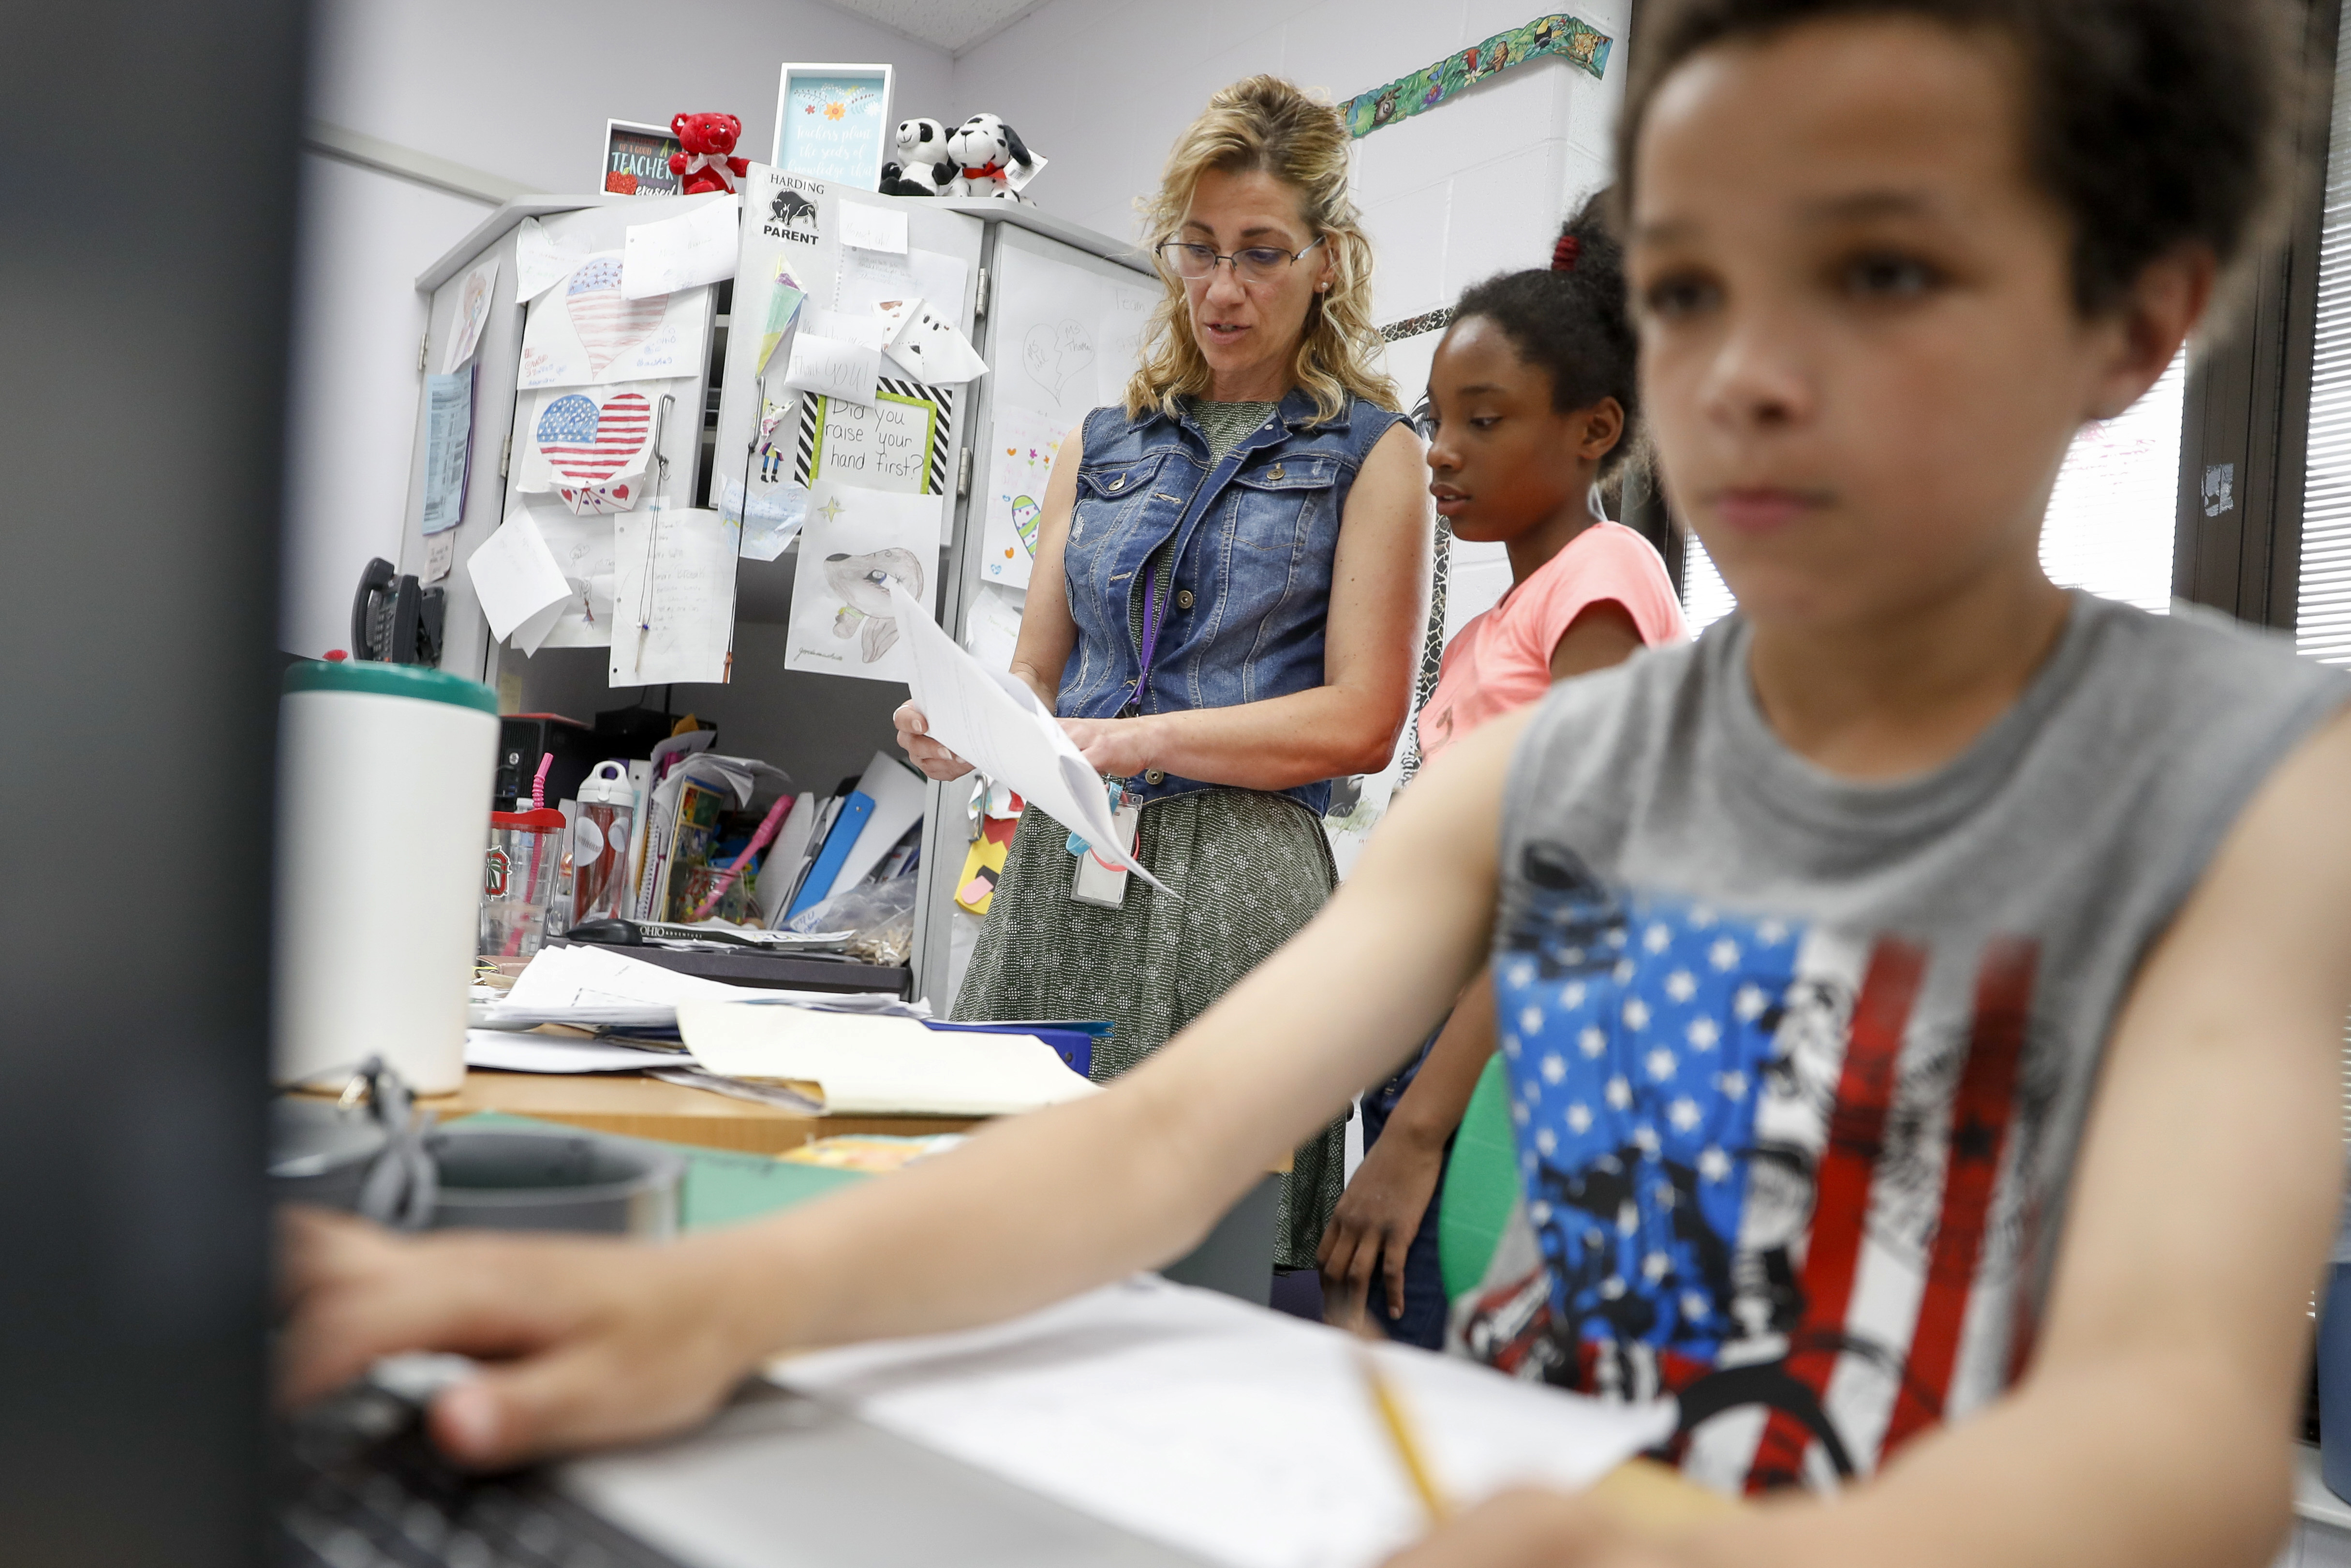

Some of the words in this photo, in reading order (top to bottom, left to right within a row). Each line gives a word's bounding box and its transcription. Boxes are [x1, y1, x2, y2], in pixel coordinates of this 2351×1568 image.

[796, 124, 838, 141] Teachers
[842, 125, 872, 143] plant
[619, 143, 627, 151] OF
[629, 145, 633, 153] A
[635, 146, 652, 155] GOOD
[799, 143, 816, 159] the
[821, 145, 849, 160] seeds
[853, 143, 867, 159] of
[851, 162, 873, 178] that
[636, 184, 676, 196] erased
[770, 174, 825, 195] HARDING
[764, 224, 819, 245] PARENT
[832, 399, 866, 420] Did
[874, 409, 905, 433] you
[825, 424, 864, 442] raise
[875, 432, 913, 455] your
[831, 444, 866, 471] hand
[876, 453, 925, 480] first?
[639, 925, 665, 937] OHIO
